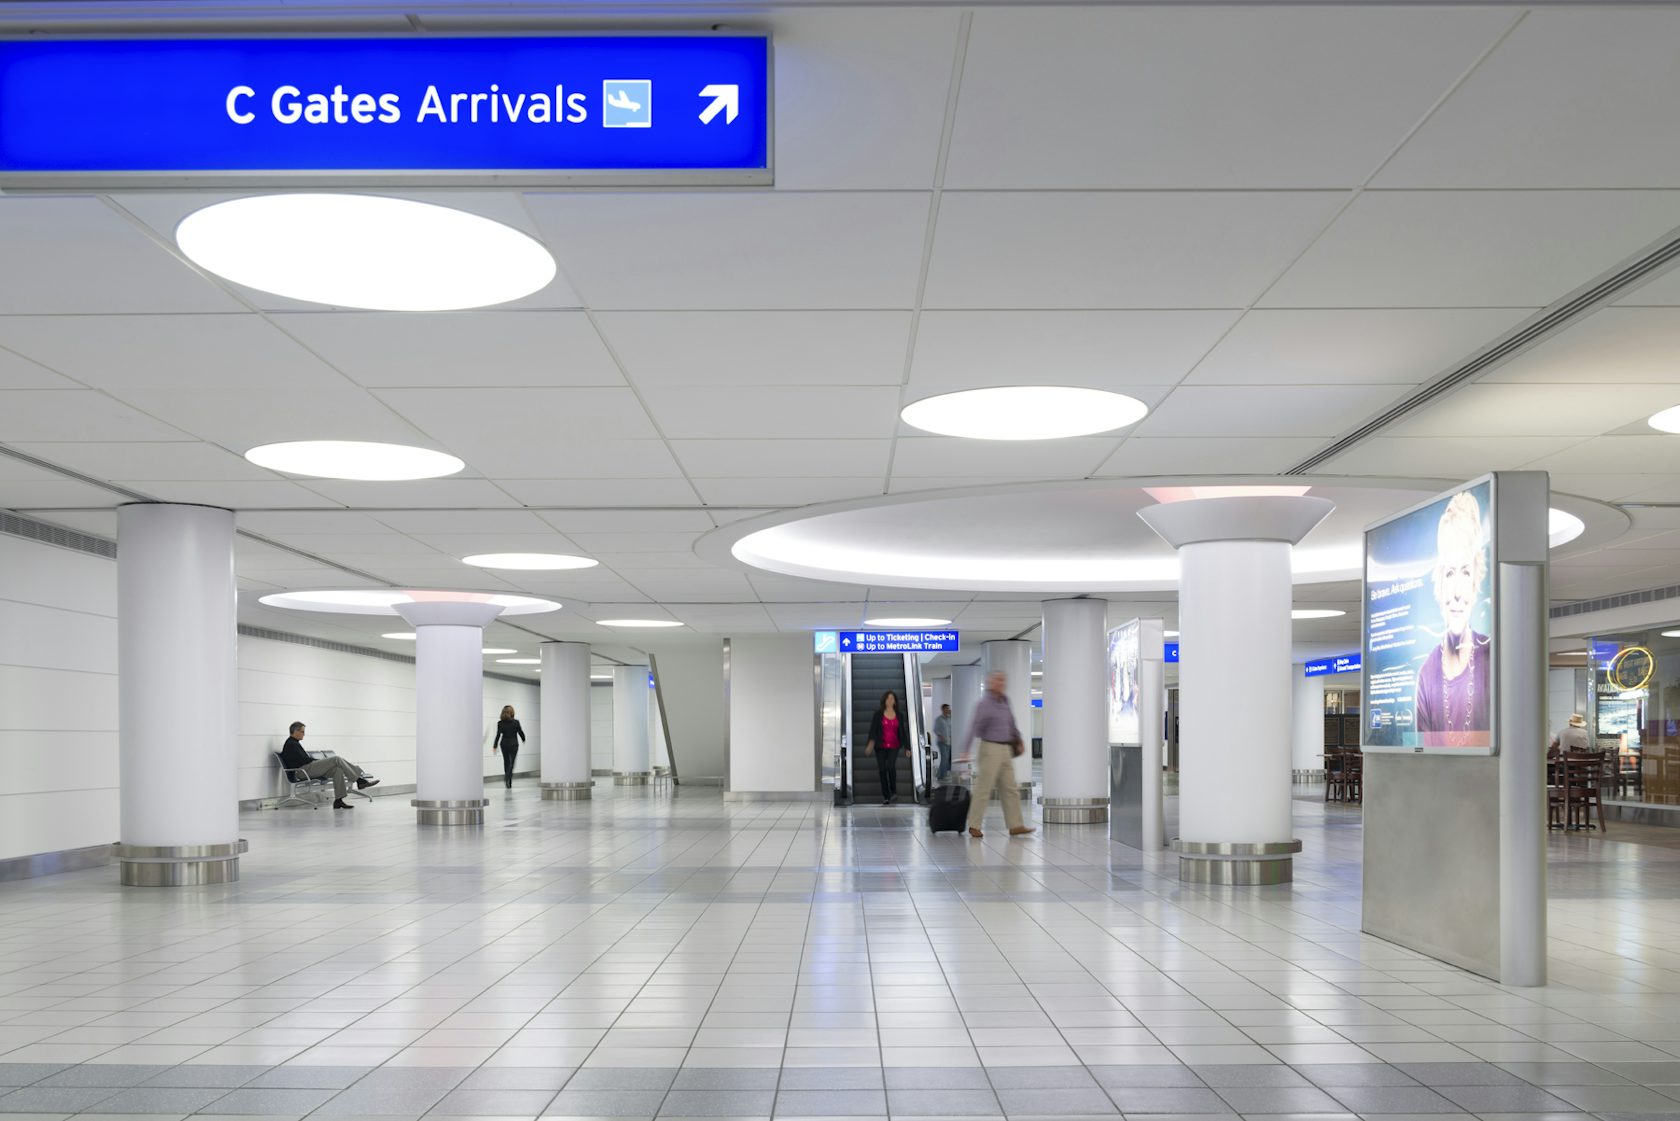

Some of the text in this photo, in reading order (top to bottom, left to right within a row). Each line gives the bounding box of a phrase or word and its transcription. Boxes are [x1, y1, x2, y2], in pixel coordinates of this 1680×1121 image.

[226, 84, 588, 124] C Gates Arrivals
[866, 634, 876, 642] Up
[886, 634, 919, 642] Ticketing
[866, 643, 876, 651] Up
